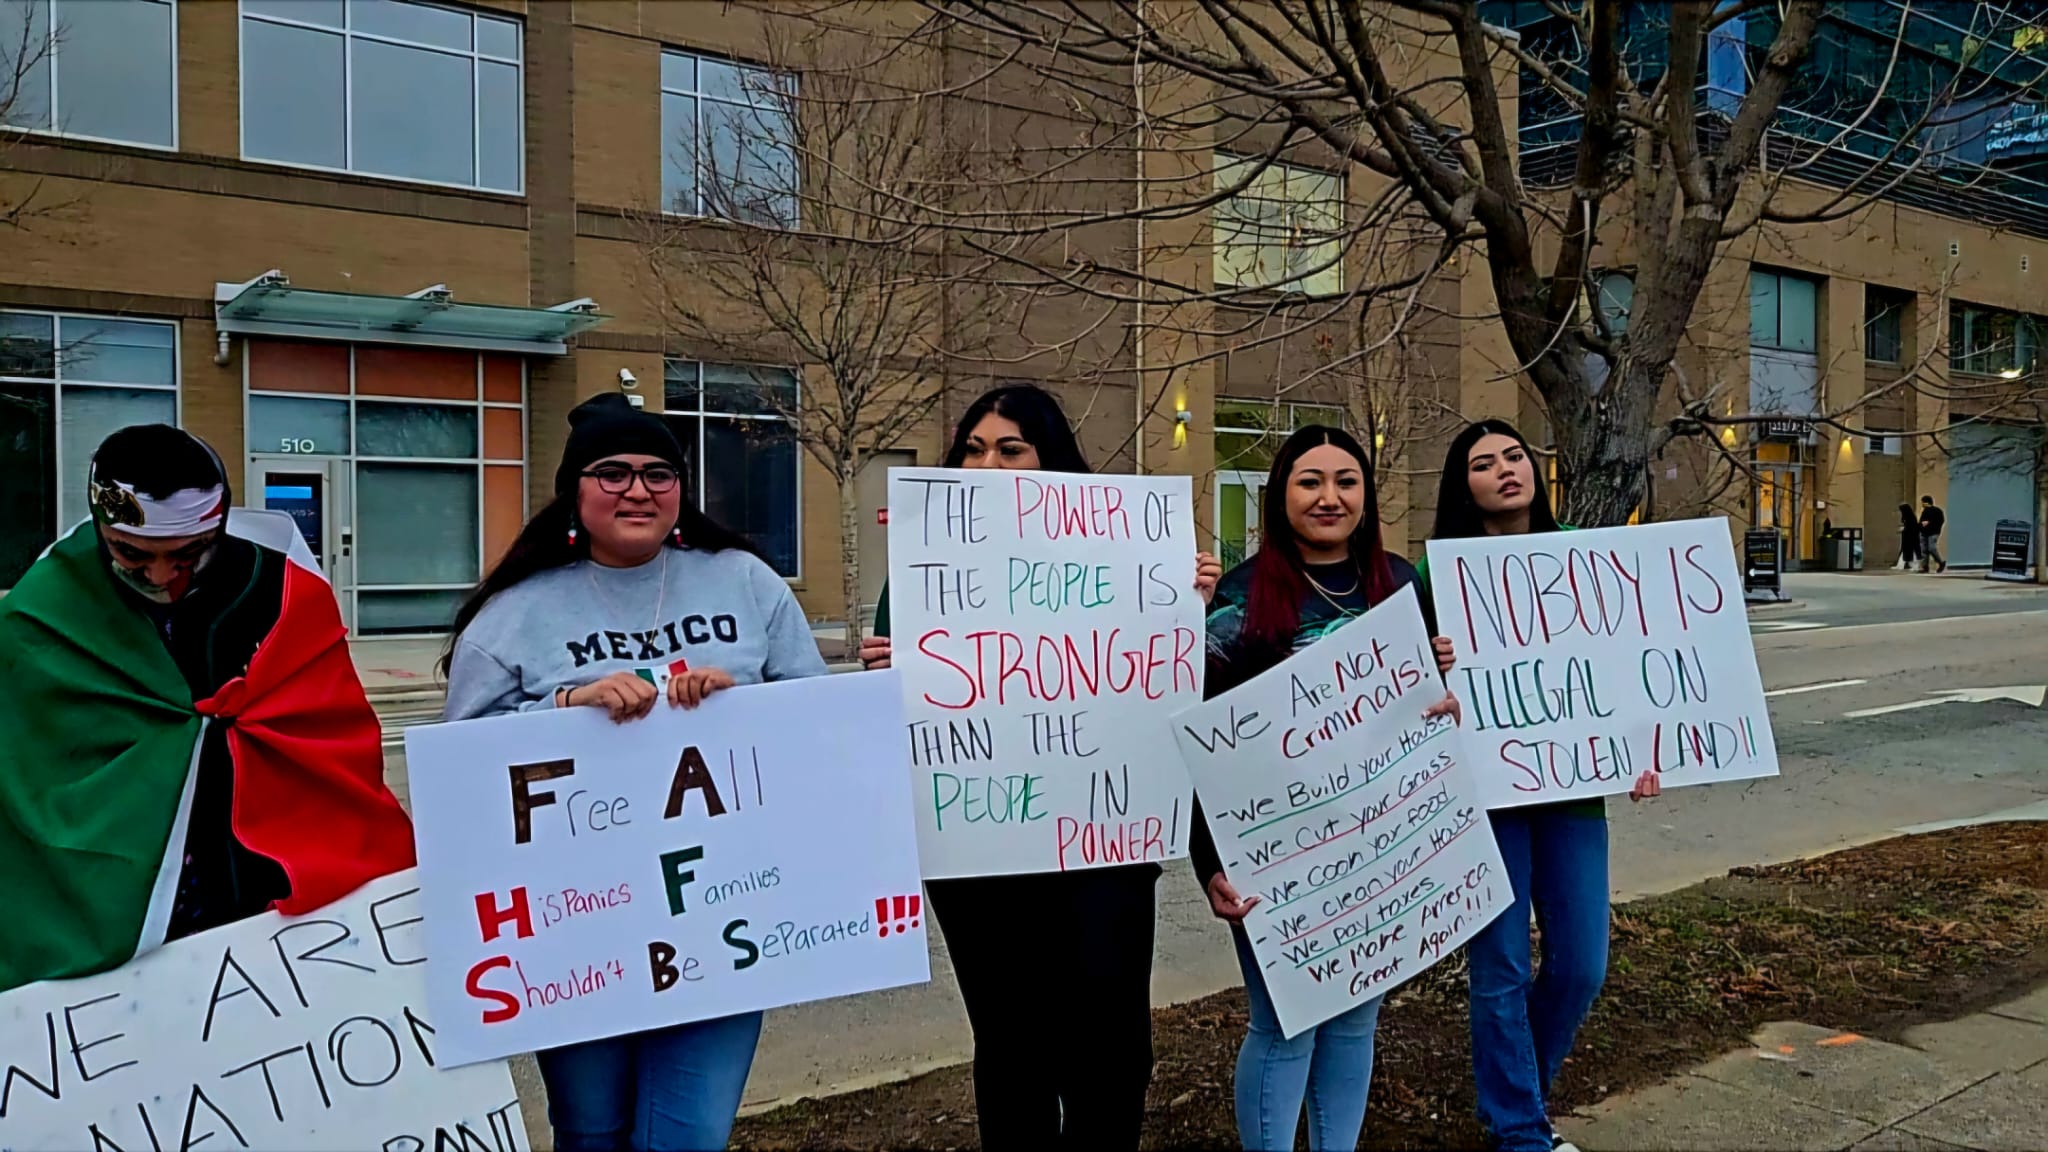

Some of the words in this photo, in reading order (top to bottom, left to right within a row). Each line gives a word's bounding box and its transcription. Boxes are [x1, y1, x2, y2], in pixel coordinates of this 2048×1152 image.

[281, 438, 315, 453] 510
[898, 477, 988, 547] THE
[1015, 476, 1130, 541] POWER
[1143, 491, 1179, 542] OF
[908, 563, 986, 615] THE
[1008, 557, 1115, 616] PEOPLE
[1138, 562, 1178, 613] IS
[1457, 547, 1648, 654] NOBODY
[1669, 544, 1723, 631] IS
[566, 614, 738, 667] MEXICO
[918, 627, 1197, 709] STRONGER
[1290, 672, 1333, 717] Are
[1460, 657, 1616, 732] ILLEGAL
[1641, 646, 1708, 709] ON
[906, 716, 993, 767] THAN
[1023, 710, 1100, 758] THE
[1500, 736, 1634, 791] STOLEN
[508, 758, 632, 845] Free
[664, 745, 764, 819] All
[1089, 764, 1129, 821] IN
[659, 845, 781, 917] Families
[202, 887, 428, 1042] ARE
[648, 941, 705, 993] Be
